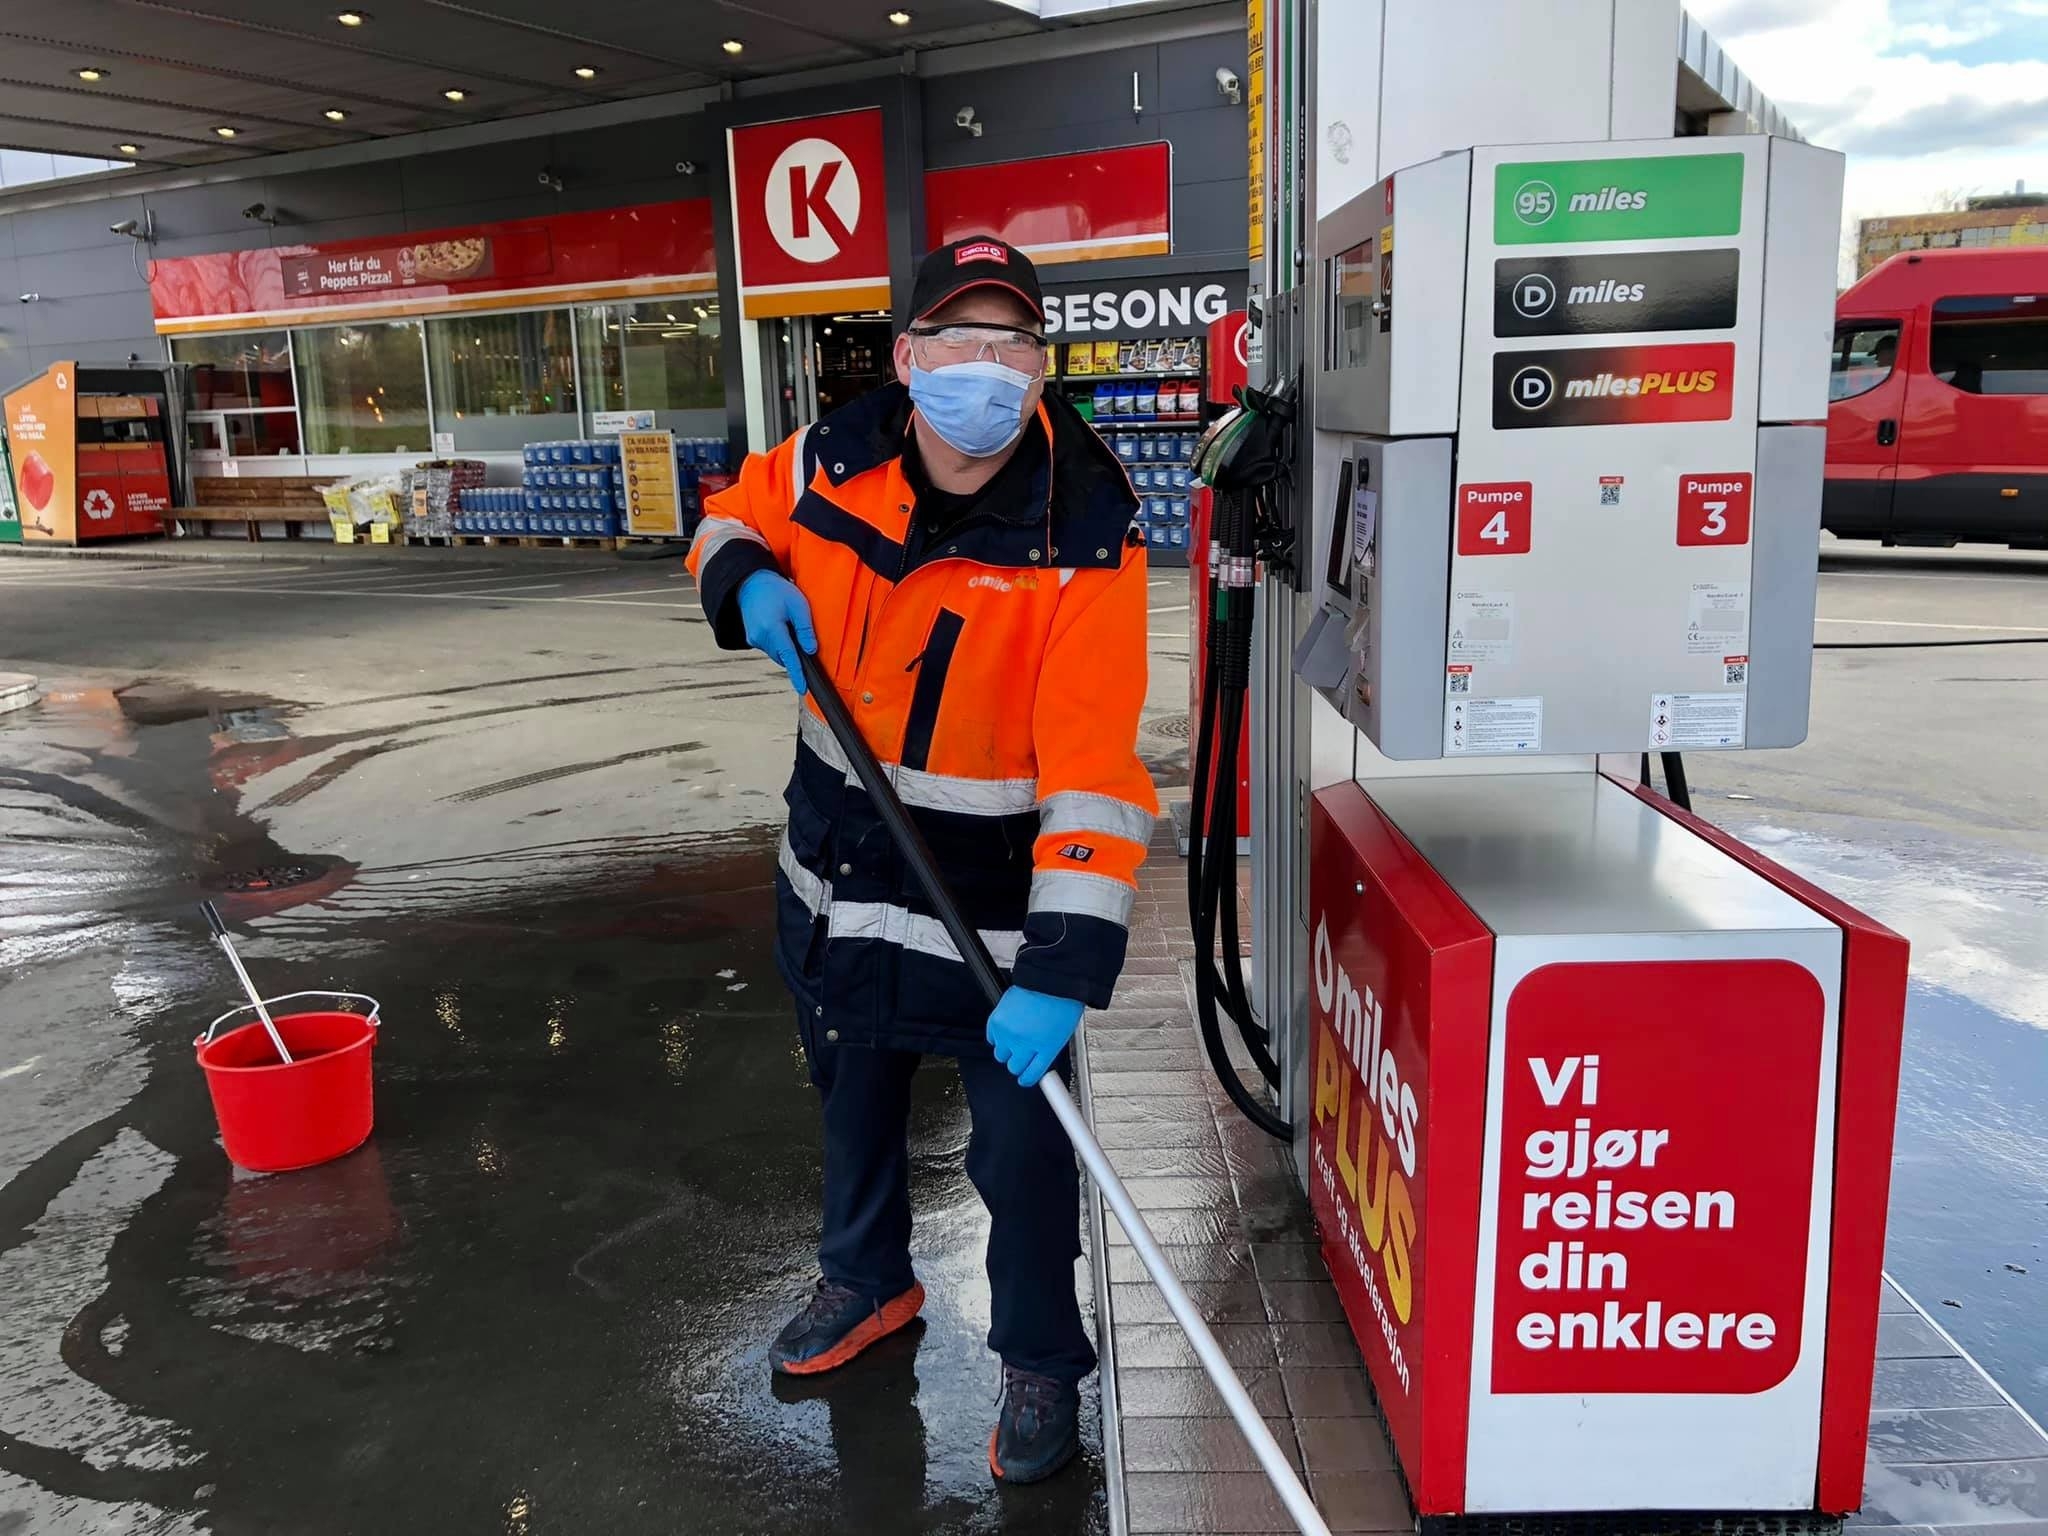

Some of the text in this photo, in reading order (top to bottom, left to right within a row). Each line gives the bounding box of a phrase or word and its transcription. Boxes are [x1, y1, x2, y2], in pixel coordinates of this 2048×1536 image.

[1519, 187, 1648, 215] 95 miles
[328, 255, 381, 273] Her får du
[961, 246, 989, 256] CIRCLE
[320, 274, 359, 290] Peppes
[360, 270, 392, 286] Pizza!
[1523, 280, 1645, 307] D miles
[1043, 284, 1227, 334] SESONG
[1522, 370, 1717, 399] D milesPLUS
[1467, 490, 1523, 504] Pumpe
[1687, 480, 1743, 495] Pumpe
[1479, 511, 1509, 545] 4
[1700, 501, 1727, 536] 3
[1527, 1054, 1600, 1106] Vi
[1524, 1118, 1669, 1178] gjør
[1315, 1018, 1417, 1325] PLUS
[1522, 1180, 1735, 1230] reisen
[1313, 1137, 1410, 1397] Kraft og akselerasjon
[1518, 1241, 1628, 1291] din
[1516, 1301, 1776, 1350] enklere
